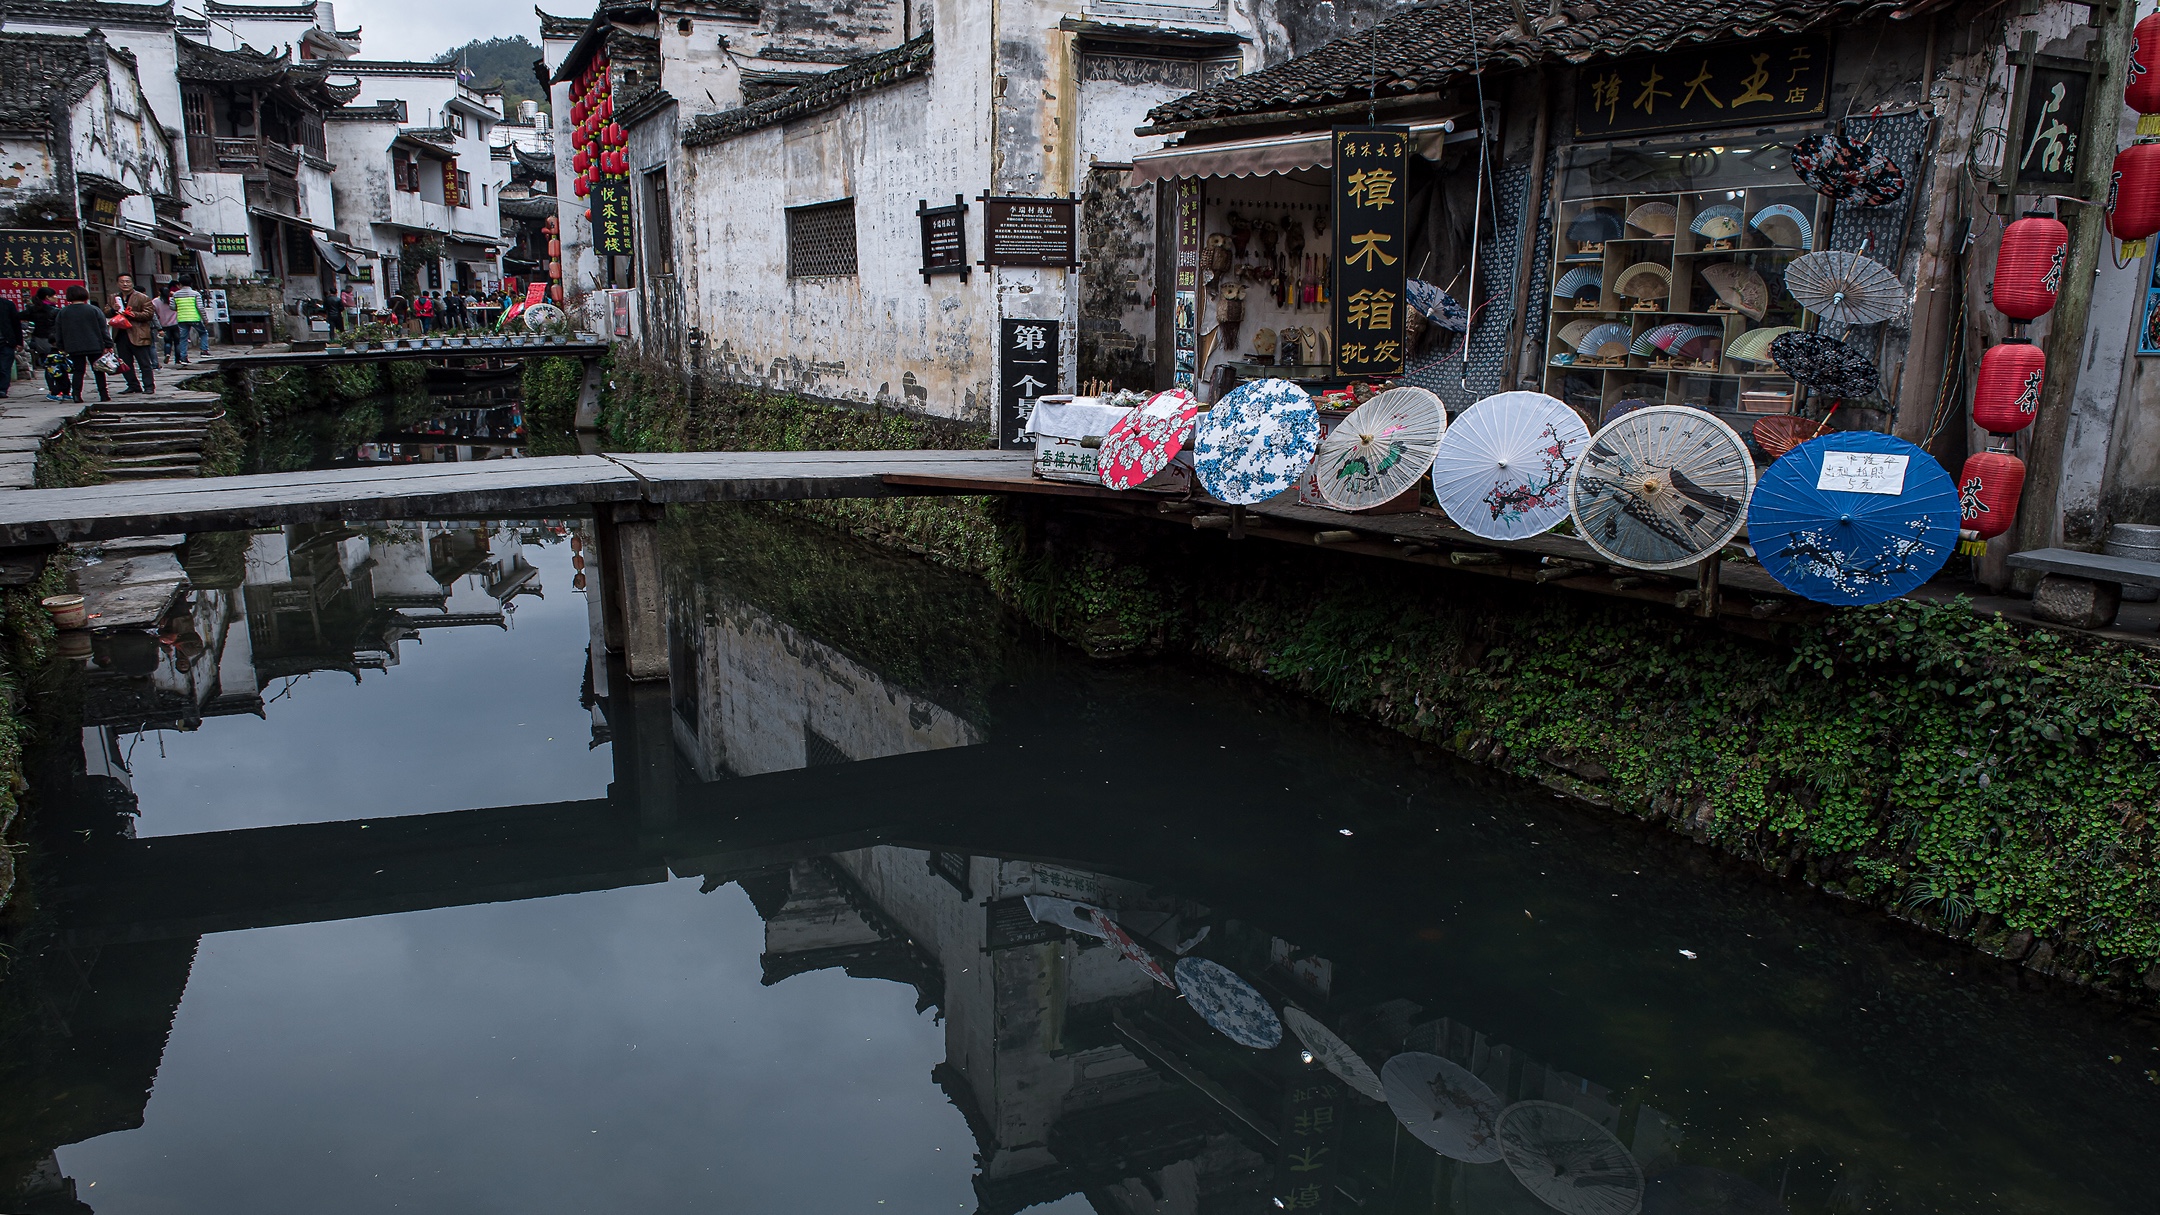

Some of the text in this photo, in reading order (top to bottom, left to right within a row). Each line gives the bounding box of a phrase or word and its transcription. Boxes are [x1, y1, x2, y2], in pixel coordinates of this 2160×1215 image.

[1592, 53, 1774, 125] 樟木大王
[1785, 47, 1811, 103] 工厂店
[1344, 142, 1402, 158] 樟木大王
[1345, 168, 1397, 330] 樟木箱
[1341, 340, 1400, 363] 批发
[2014, 368, 2042, 415] 茶
[1824, 464, 1886, 479] 出租拍照
[1847, 478, 1873, 490] 5元
[1960, 477, 1990, 521] 茶
